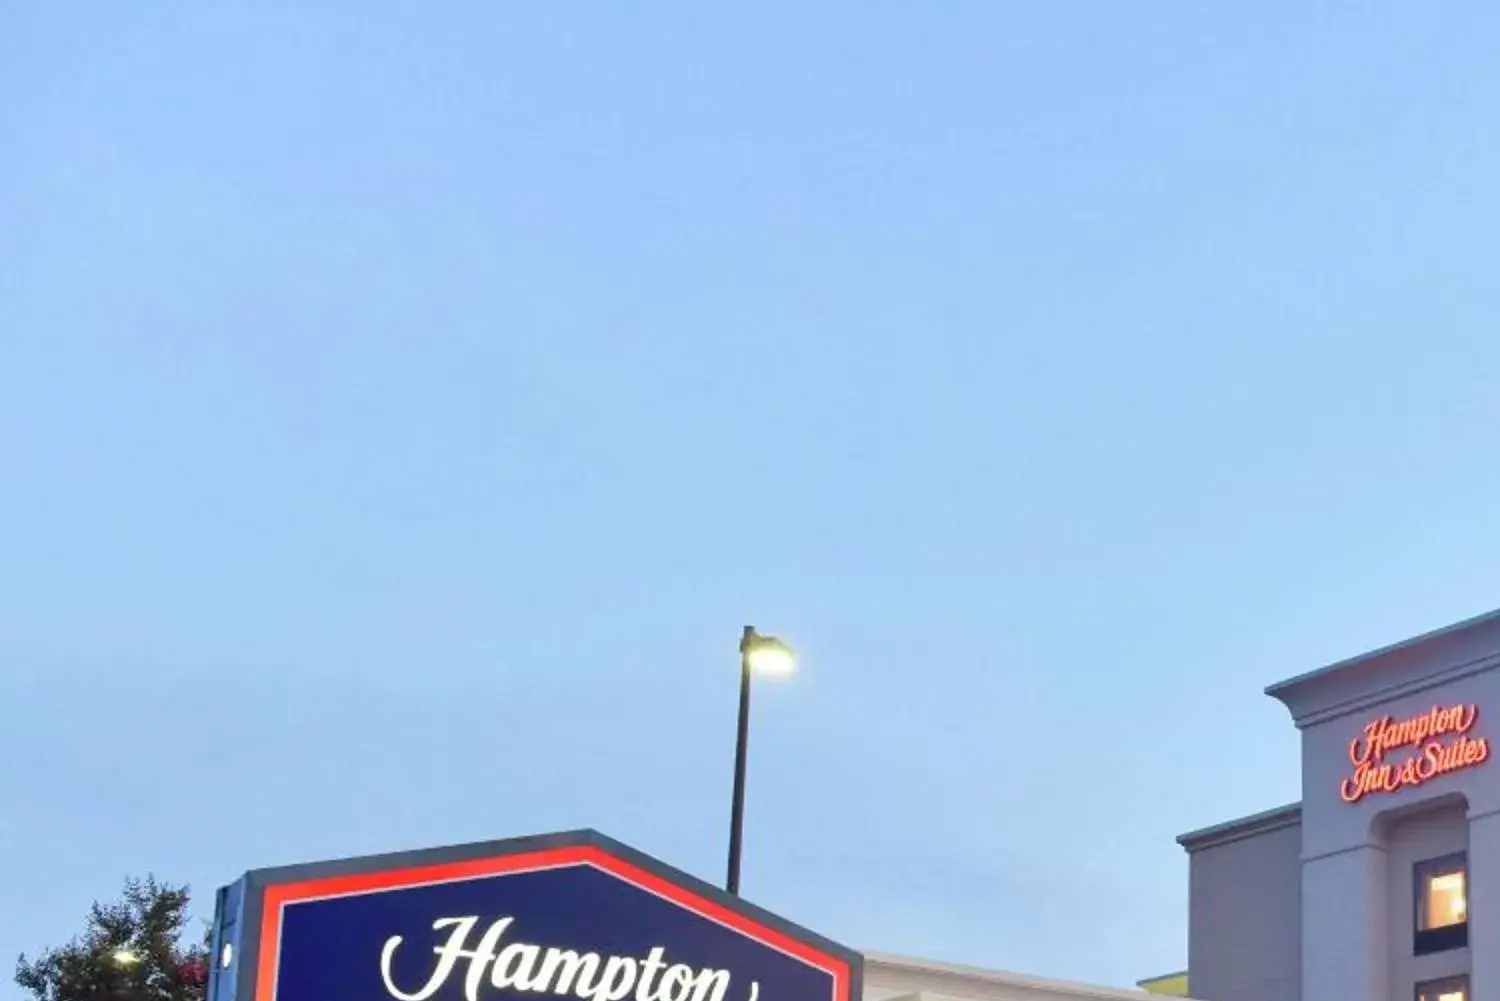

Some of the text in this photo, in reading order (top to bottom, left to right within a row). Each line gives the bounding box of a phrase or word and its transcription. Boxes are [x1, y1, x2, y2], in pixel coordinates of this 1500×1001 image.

[1350, 703, 1476, 766] Hampton
[1341, 761, 1401, 801] Inn
[1417, 735, 1487, 779] Suites
